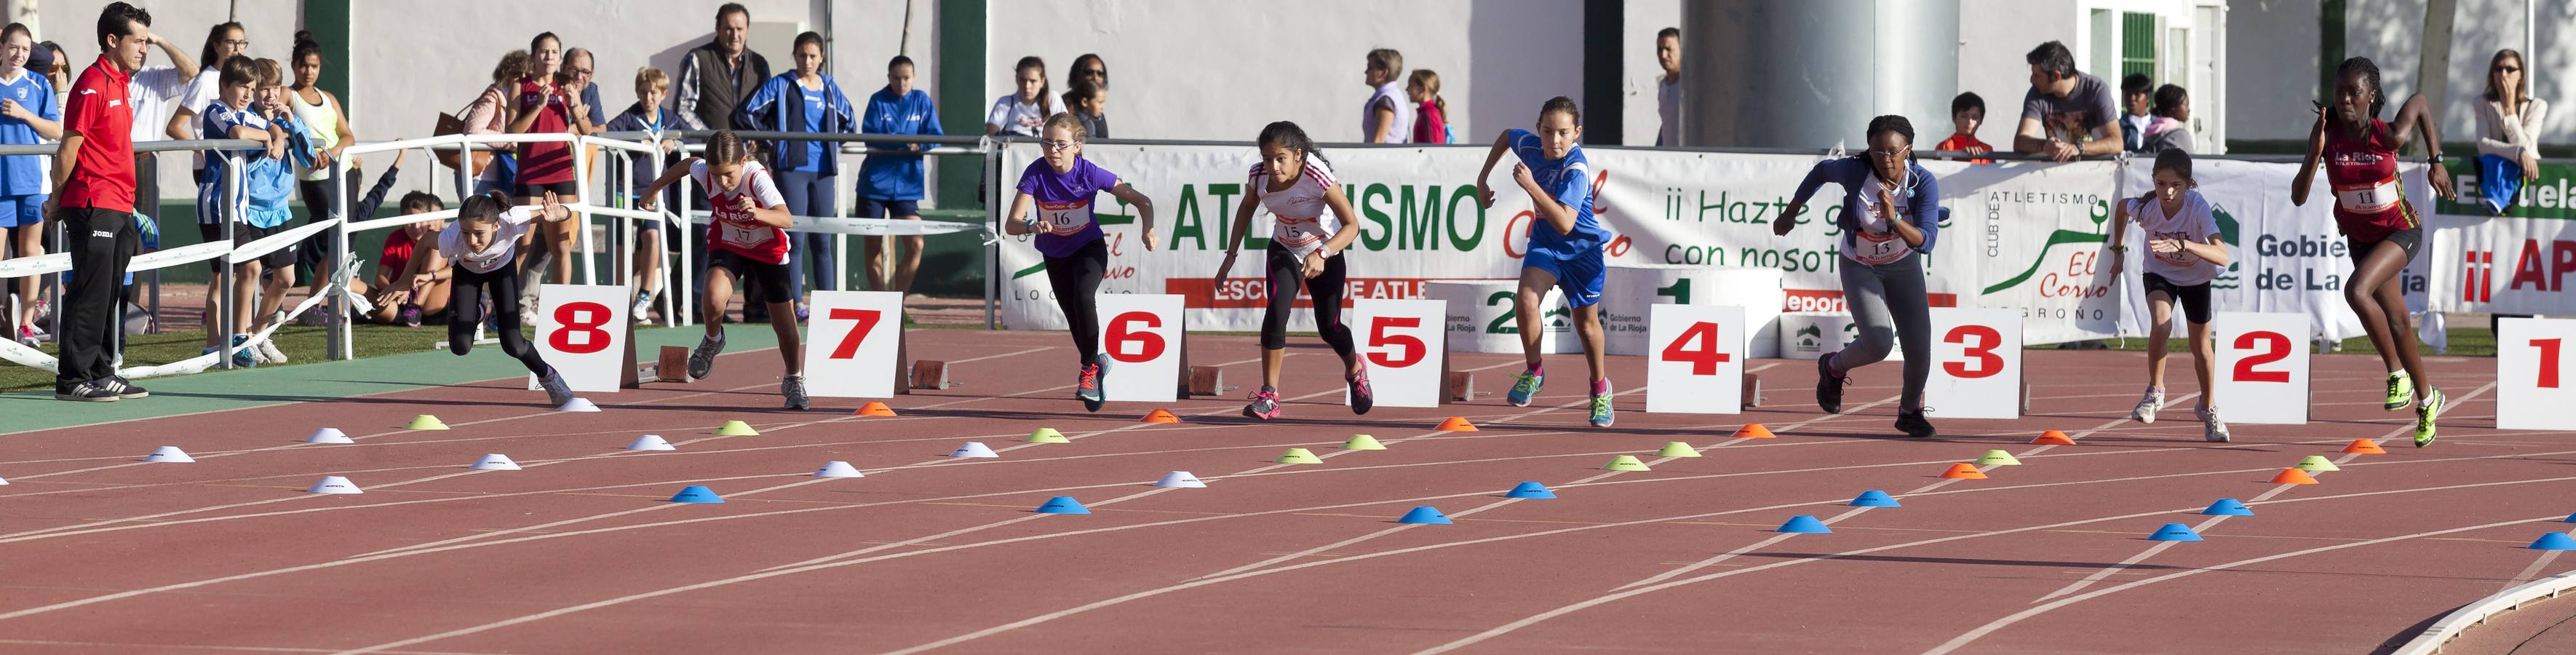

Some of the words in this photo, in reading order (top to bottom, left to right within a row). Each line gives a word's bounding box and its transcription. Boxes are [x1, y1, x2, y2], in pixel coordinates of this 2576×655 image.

[2335, 151, 2349, 161] La
[1991, 191, 2098, 205] ATLETISMO
[2358, 191, 2375, 204] 11
[2457, 174, 2576, 209] Euel
[1052, 212, 1070, 225] 16
[1169, 183, 1486, 252] ATLISMO
[1989, 202, 2000, 221] DE
[736, 228, 750, 241] 17
[1284, 226, 1300, 238] 15
[1987, 224, 1999, 258] CLUB
[1665, 244, 1725, 266] con
[1872, 243, 1890, 255] 13
[2069, 250, 2096, 277] El
[2255, 268, 2294, 290] de
[2306, 268, 2340, 291] La
[1486, 291, 1524, 334] 2
[1610, 314, 1642, 322] Gobierno
[549, 302, 612, 354] 8
[830, 309, 880, 359] 7
[1105, 311, 1165, 362] 6
[1628, 324, 1647, 333] Rioja
[1367, 317, 1426, 368] 5
[1662, 322, 1730, 376] 4
[1944, 325, 2003, 378] 3
[2233, 331, 2291, 383] 2
[2529, 338, 2561, 389] 1
